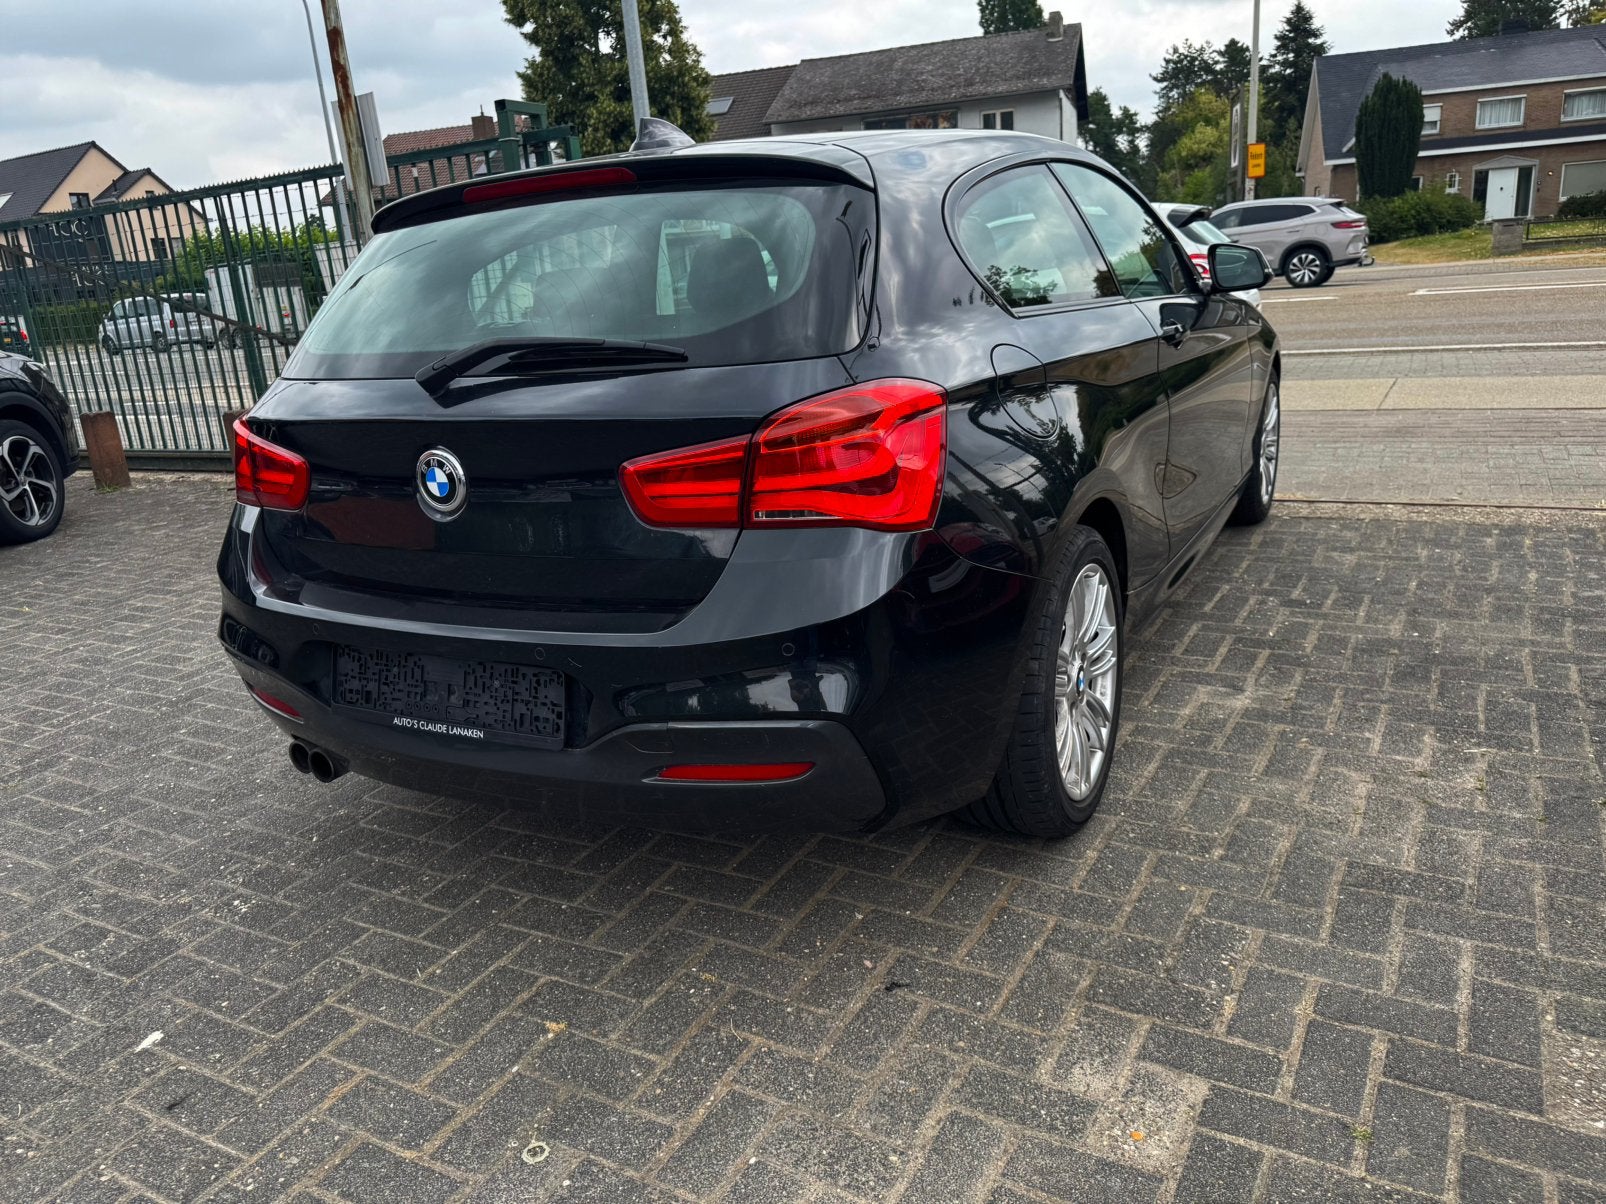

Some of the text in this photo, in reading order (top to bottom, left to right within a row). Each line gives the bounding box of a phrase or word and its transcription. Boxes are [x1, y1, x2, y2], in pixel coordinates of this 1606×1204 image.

[421, 458, 452, 475] BMW
[393, 717, 484, 738] AUTO'S CLAUDE LANAKEN
